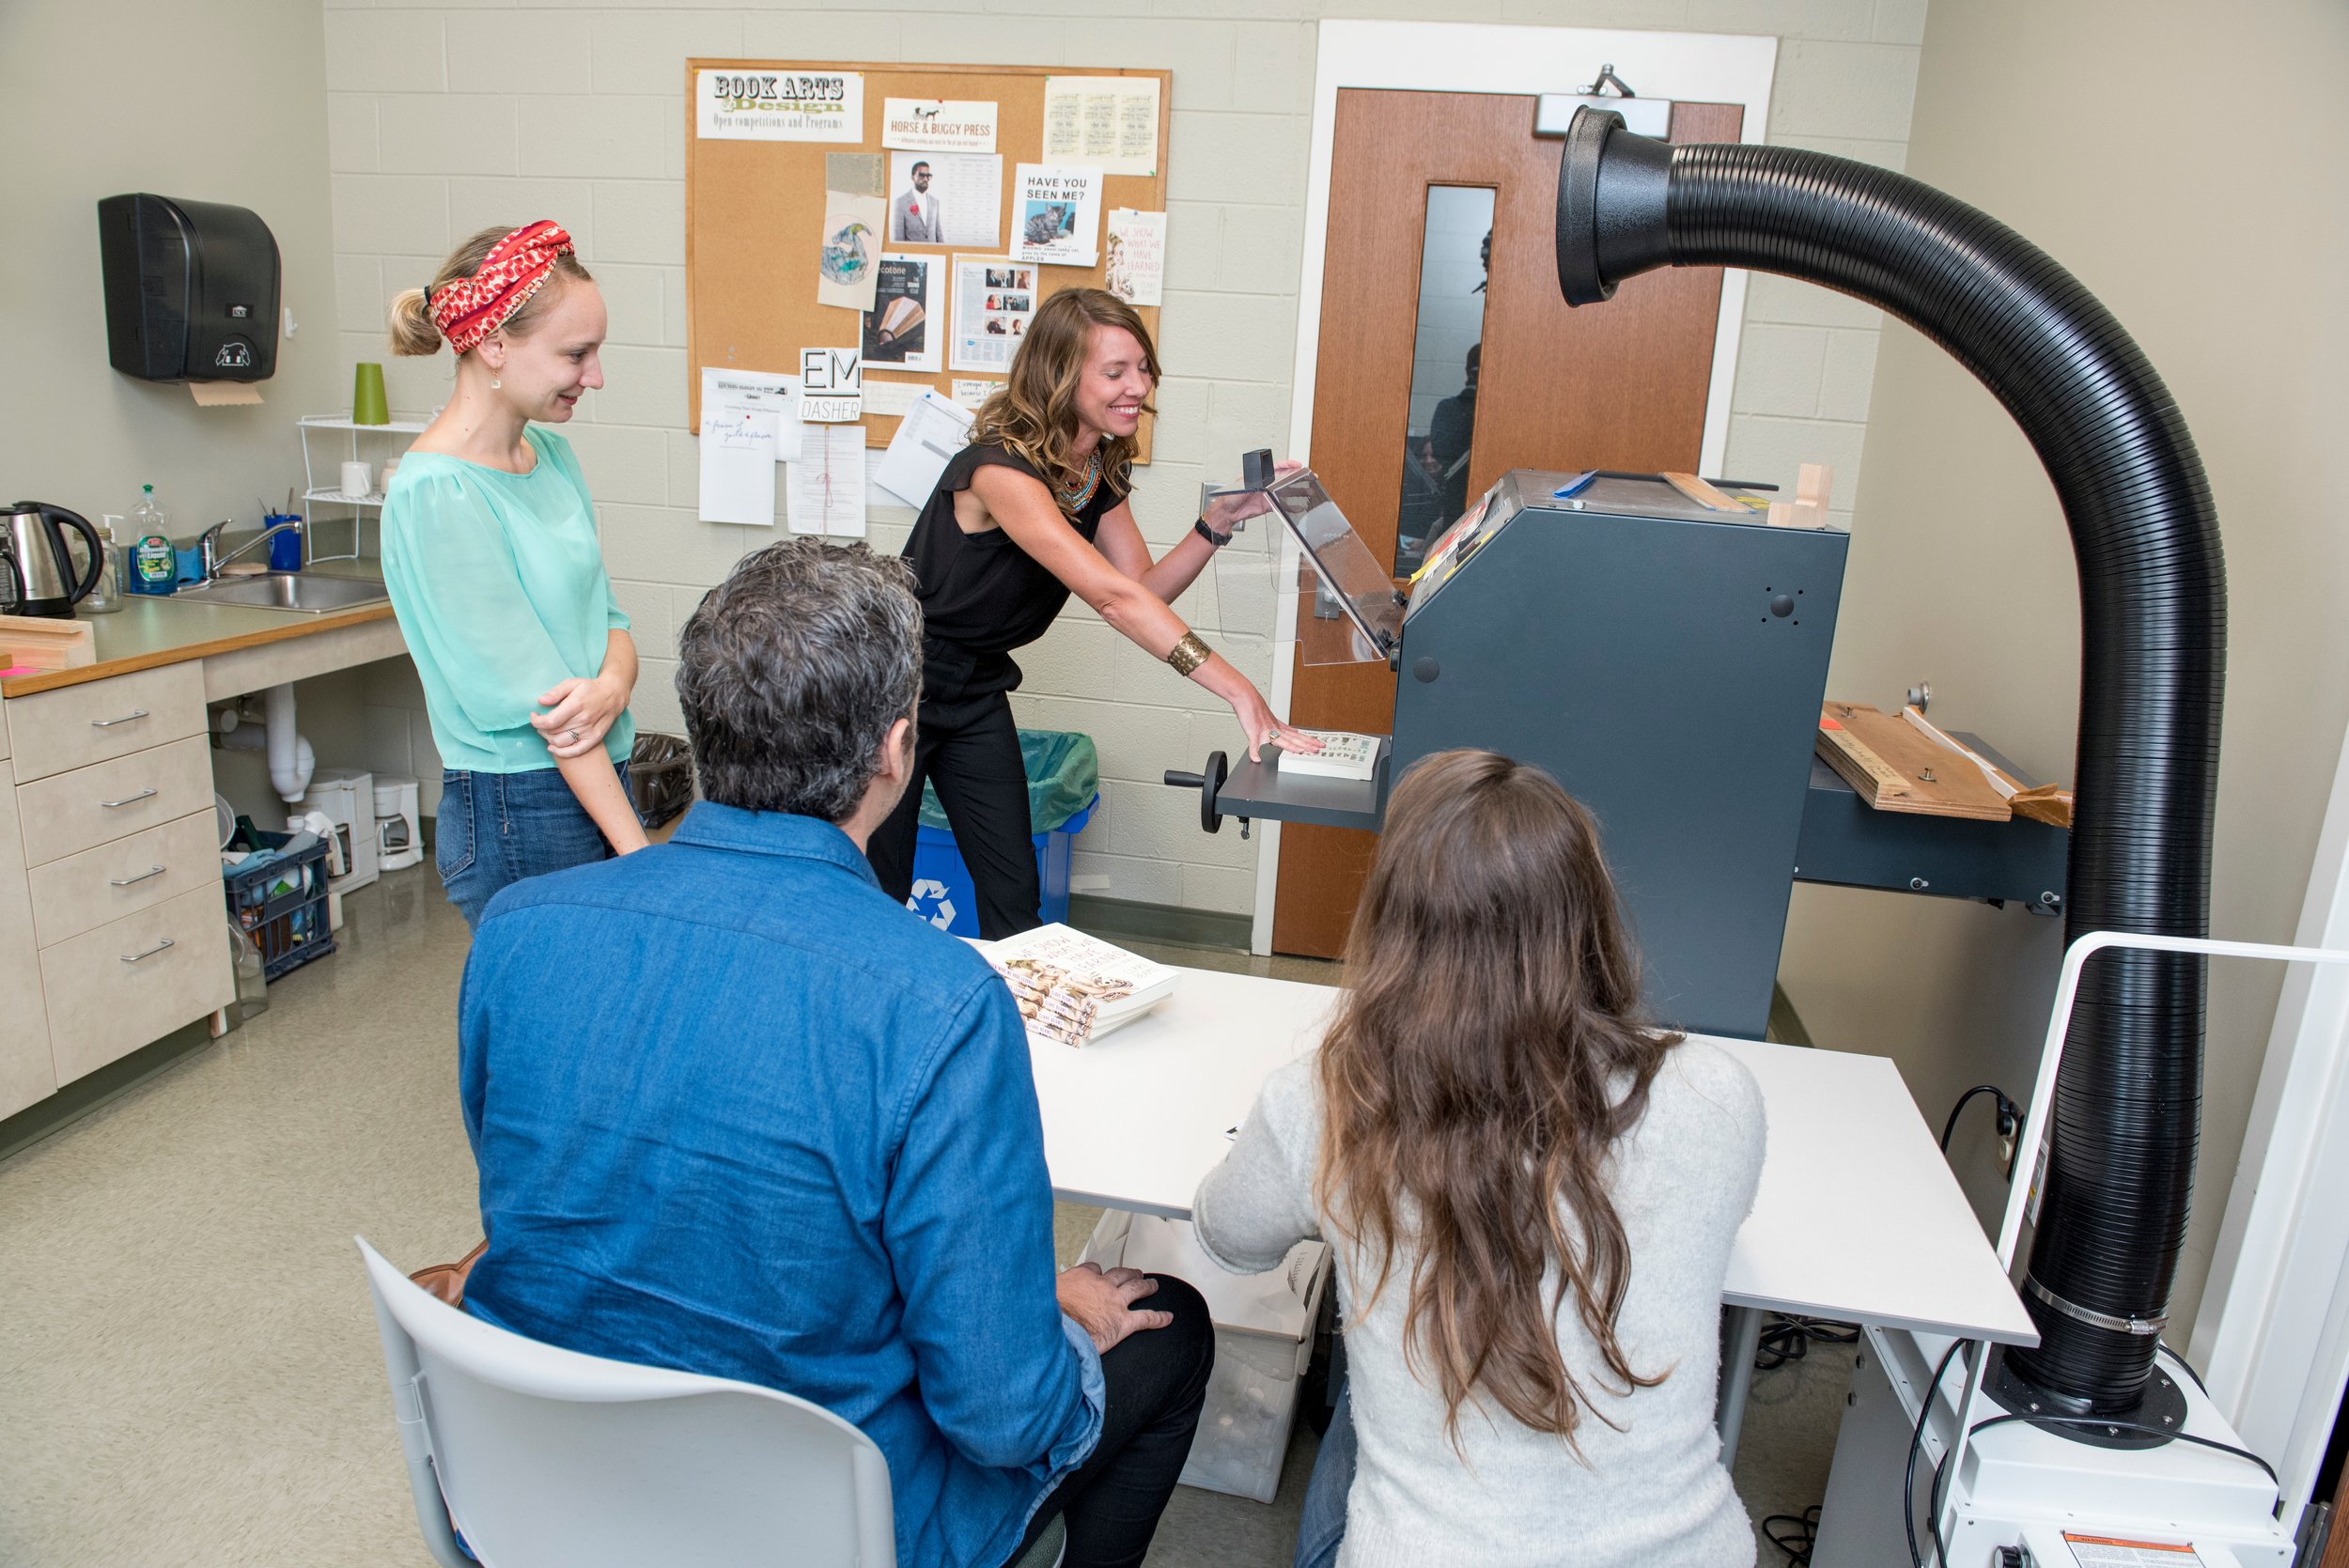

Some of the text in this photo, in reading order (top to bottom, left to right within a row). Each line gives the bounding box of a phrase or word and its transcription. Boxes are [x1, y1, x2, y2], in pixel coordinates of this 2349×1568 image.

[714, 75, 844, 100] BOOK ARTS
[734, 98, 844, 114] Design
[714, 113, 843, 131] Open competitions and Programs
[891, 120, 990, 136] HORSE & BUGGY PRESS
[1028, 177, 1087, 188] HAVE YOU
[1027, 189, 1085, 200] SEEN ME?
[1120, 227, 1153, 238] WE SHOW
[1128, 239, 1148, 248] WHAT
[1133, 250, 1151, 259] HAVE
[1128, 262, 1160, 271] LEARNED
[803, 349, 860, 388] EM
[801, 401, 859, 419] DASHER
[1015, 946, 1036, 958] WE
[1034, 935, 1070, 951] SHOW
[1043, 938, 1097, 959] WHAT WE
[1068, 948, 1100, 962] HAVE
[1074, 951, 1127, 971] LEARNED
